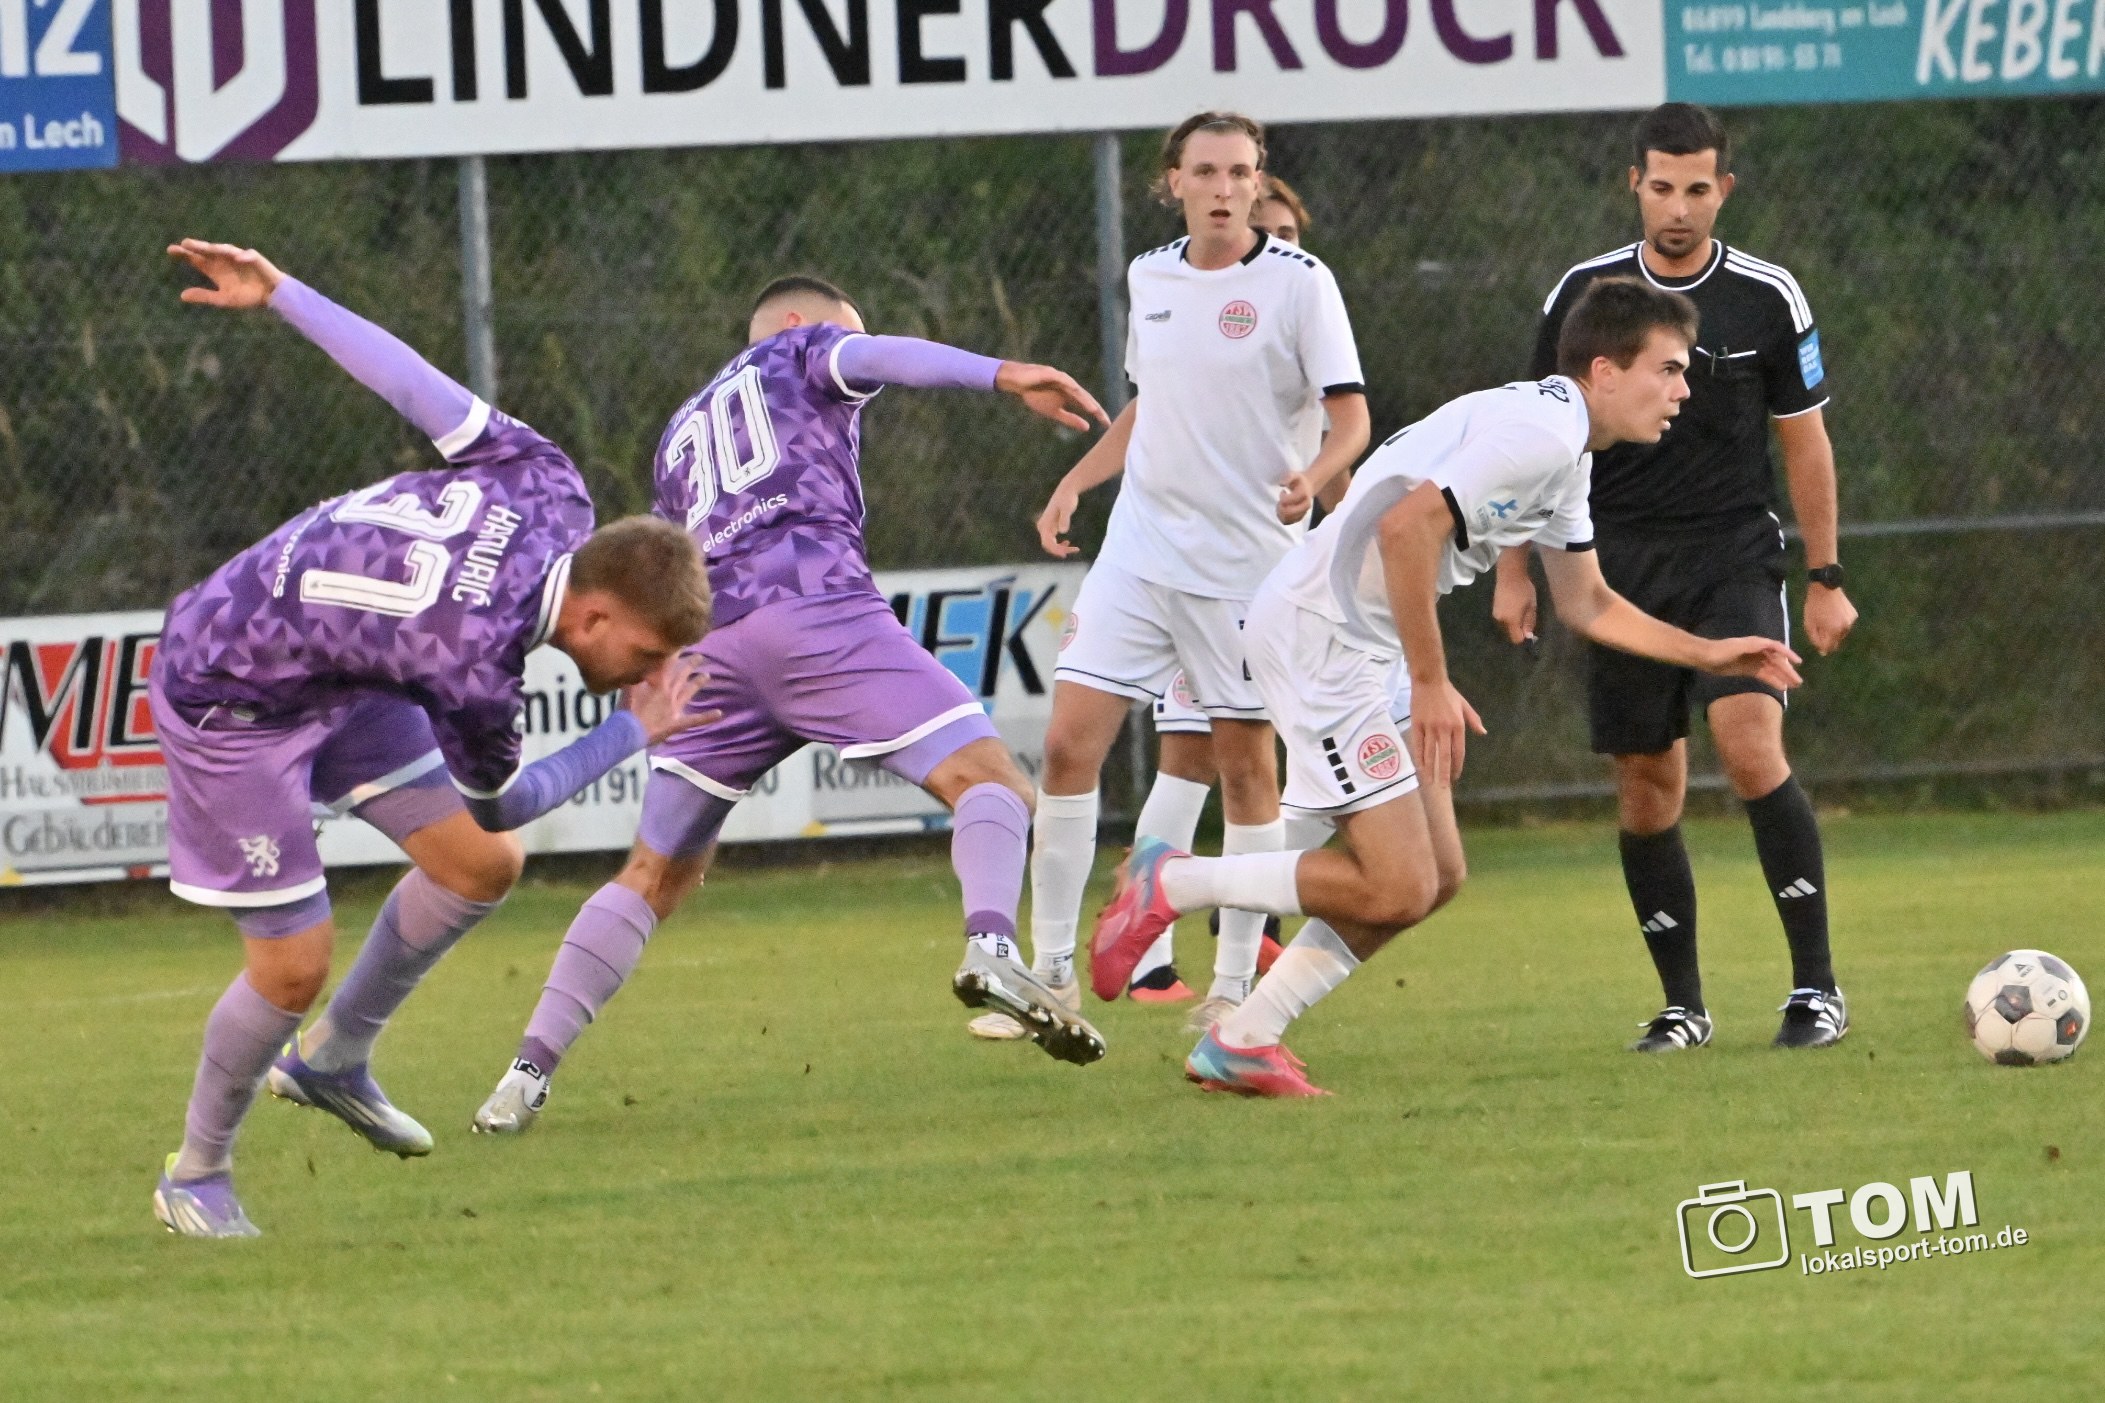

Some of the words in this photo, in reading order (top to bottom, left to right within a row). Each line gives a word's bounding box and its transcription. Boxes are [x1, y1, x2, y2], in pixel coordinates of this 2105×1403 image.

[24, 111, 105, 149] Lech
[665, 364, 781, 533] 30
[702, 493, 788, 553] electronics
